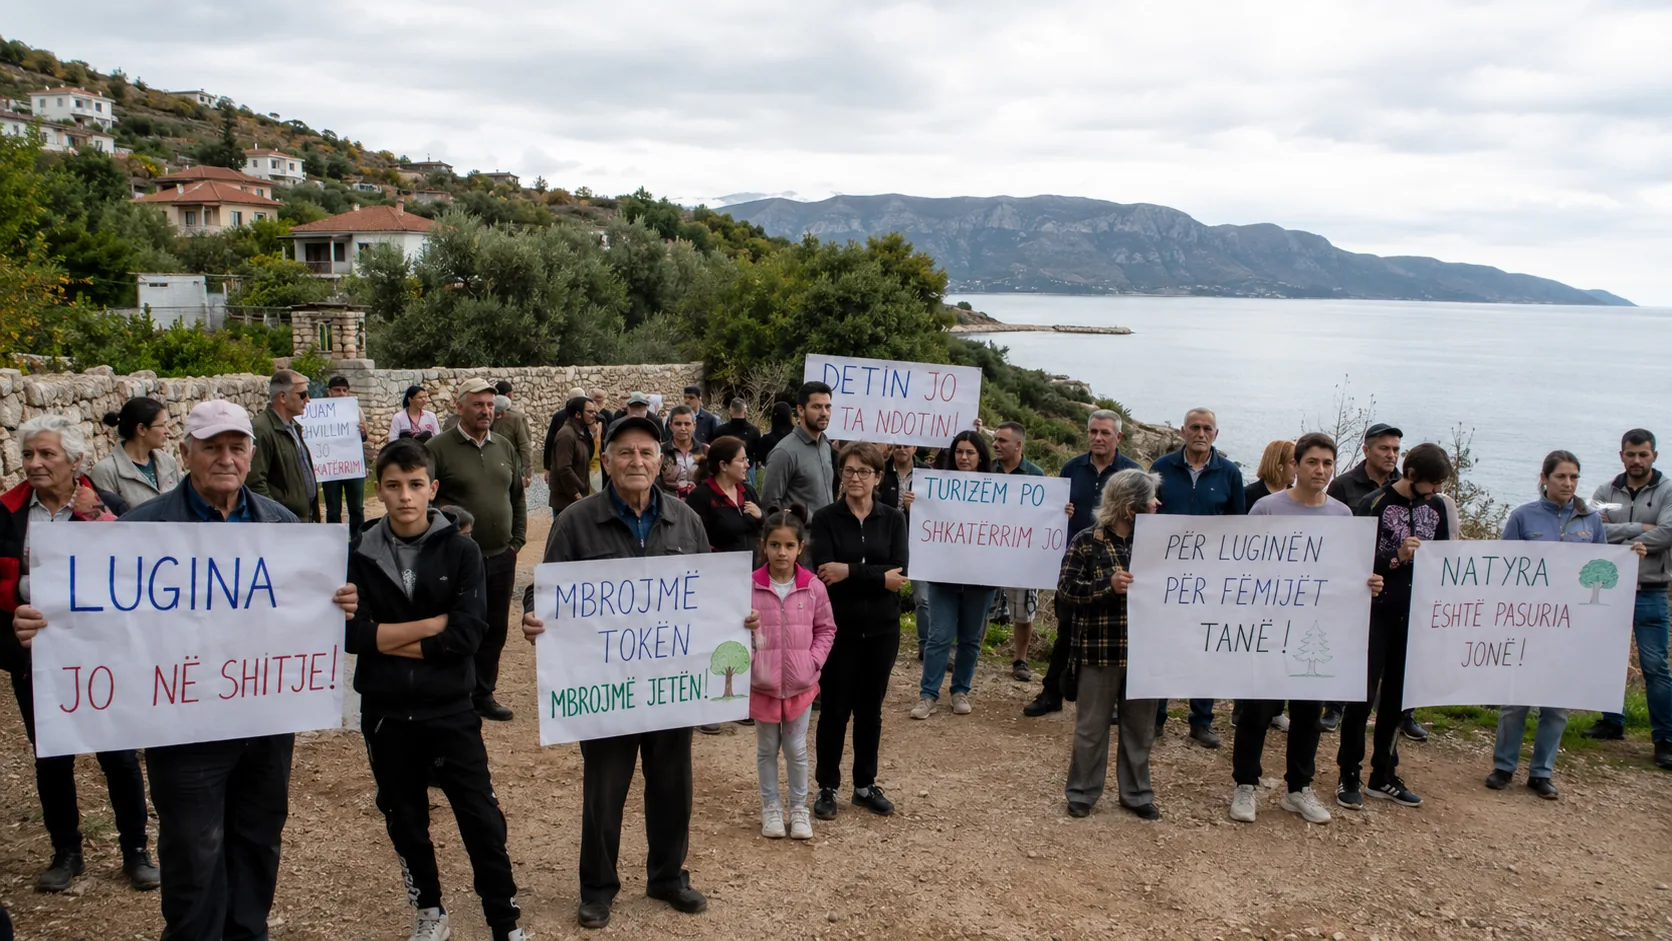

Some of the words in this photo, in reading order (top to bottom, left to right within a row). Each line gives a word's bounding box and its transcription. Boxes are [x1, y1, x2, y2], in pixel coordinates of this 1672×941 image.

[924, 372, 956, 402] JO
[303, 422, 350, 438] HVILLIM
[841, 407, 864, 431] TA
[316, 442, 330, 458] JO
[314, 459, 364, 475] KATËRRIM!
[924, 476, 1008, 504] TURIZËM
[1020, 484, 1044, 506] PO
[1042, 528, 1063, 550] JO
[1165, 531, 1205, 560] PËR
[69, 555, 277, 612] LUGINA
[1441, 556, 1548, 586] NATYRA
[555, 570, 699, 619] MBROJMË
[1164, 573, 1206, 604] PËR
[1432, 599, 1484, 628] ËSHTË
[1495, 602, 1570, 628] PASURIA
[598, 621, 690, 663] TOKËN
[1461, 638, 1525, 667] JONË!
[60, 665, 114, 713] JO
[153, 655, 200, 706] NË
[552, 677, 635, 718] MBROJMË
[647, 667, 709, 706] JETËN!
